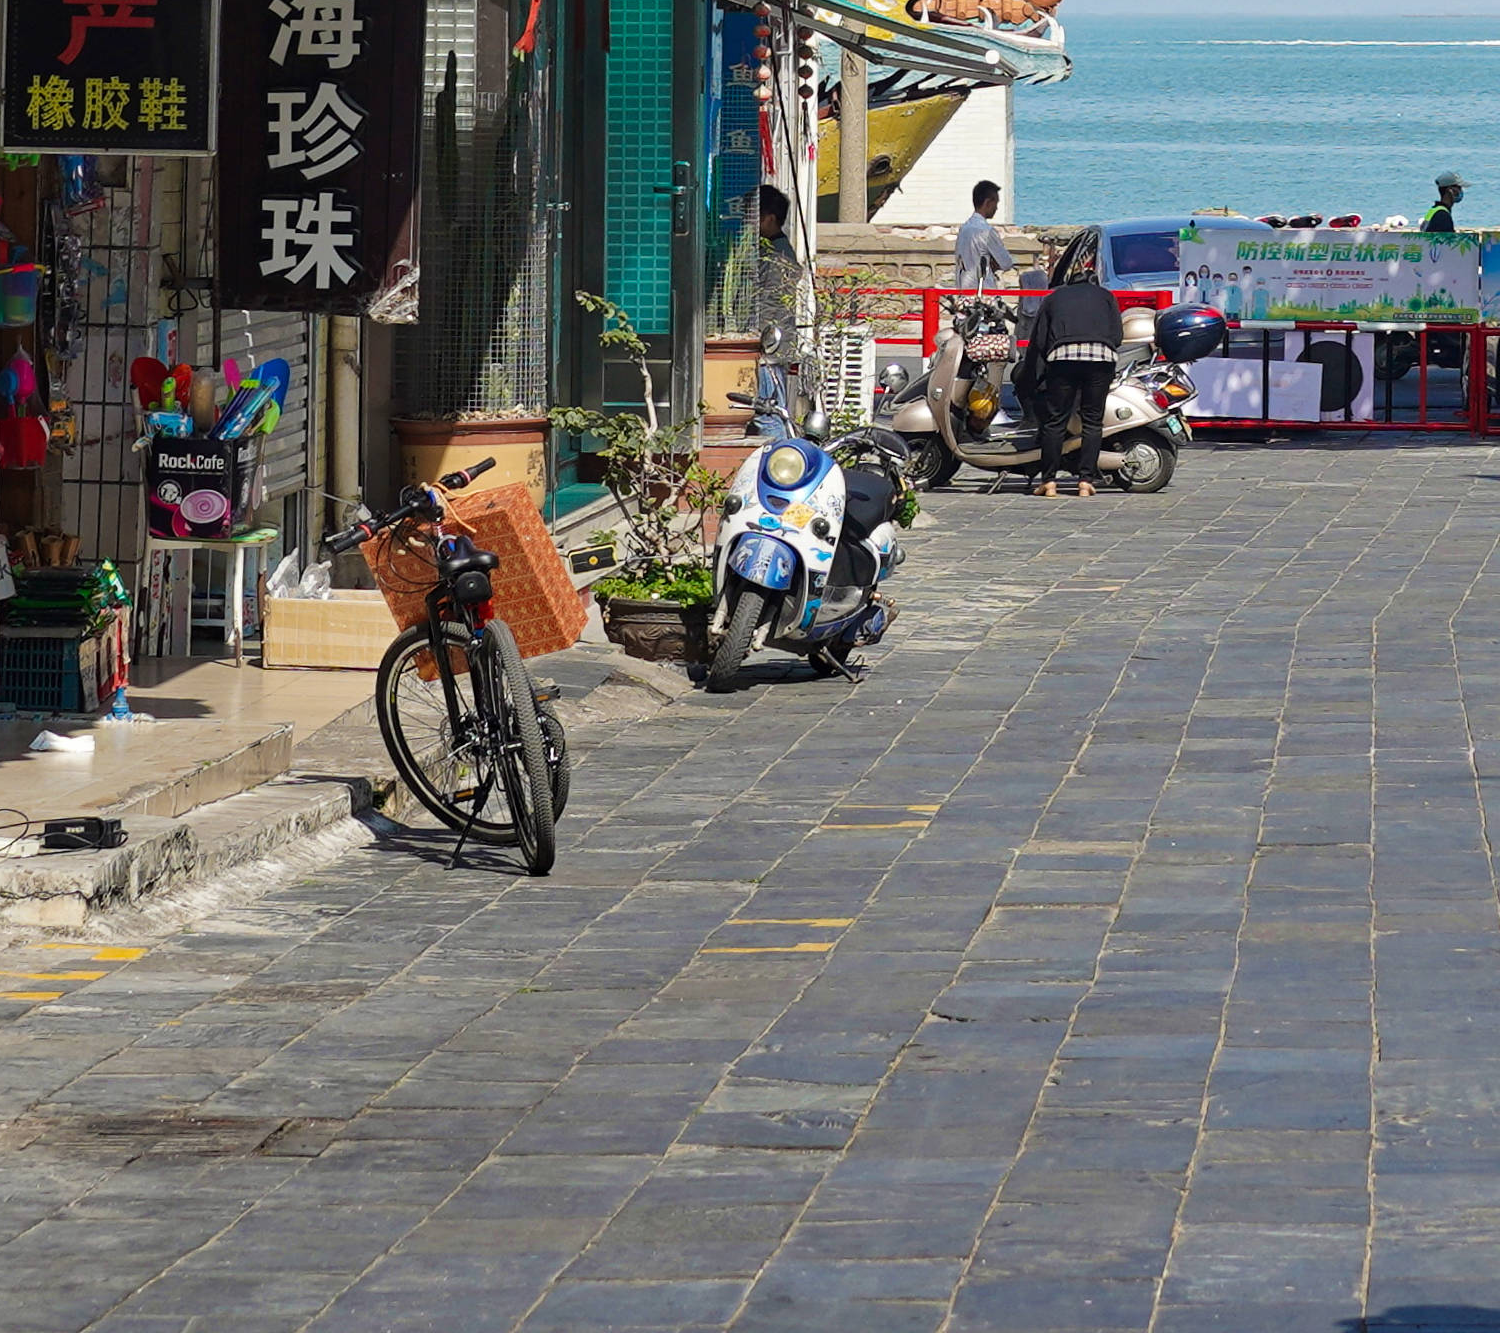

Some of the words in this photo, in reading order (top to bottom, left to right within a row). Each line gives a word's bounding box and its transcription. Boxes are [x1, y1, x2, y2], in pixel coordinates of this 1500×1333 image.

[26, 74, 189, 134] 橡胶鞋
[1235, 240, 1424, 264] 防控新型冠状病毒
[158, 453, 225, 470] RockCafe
